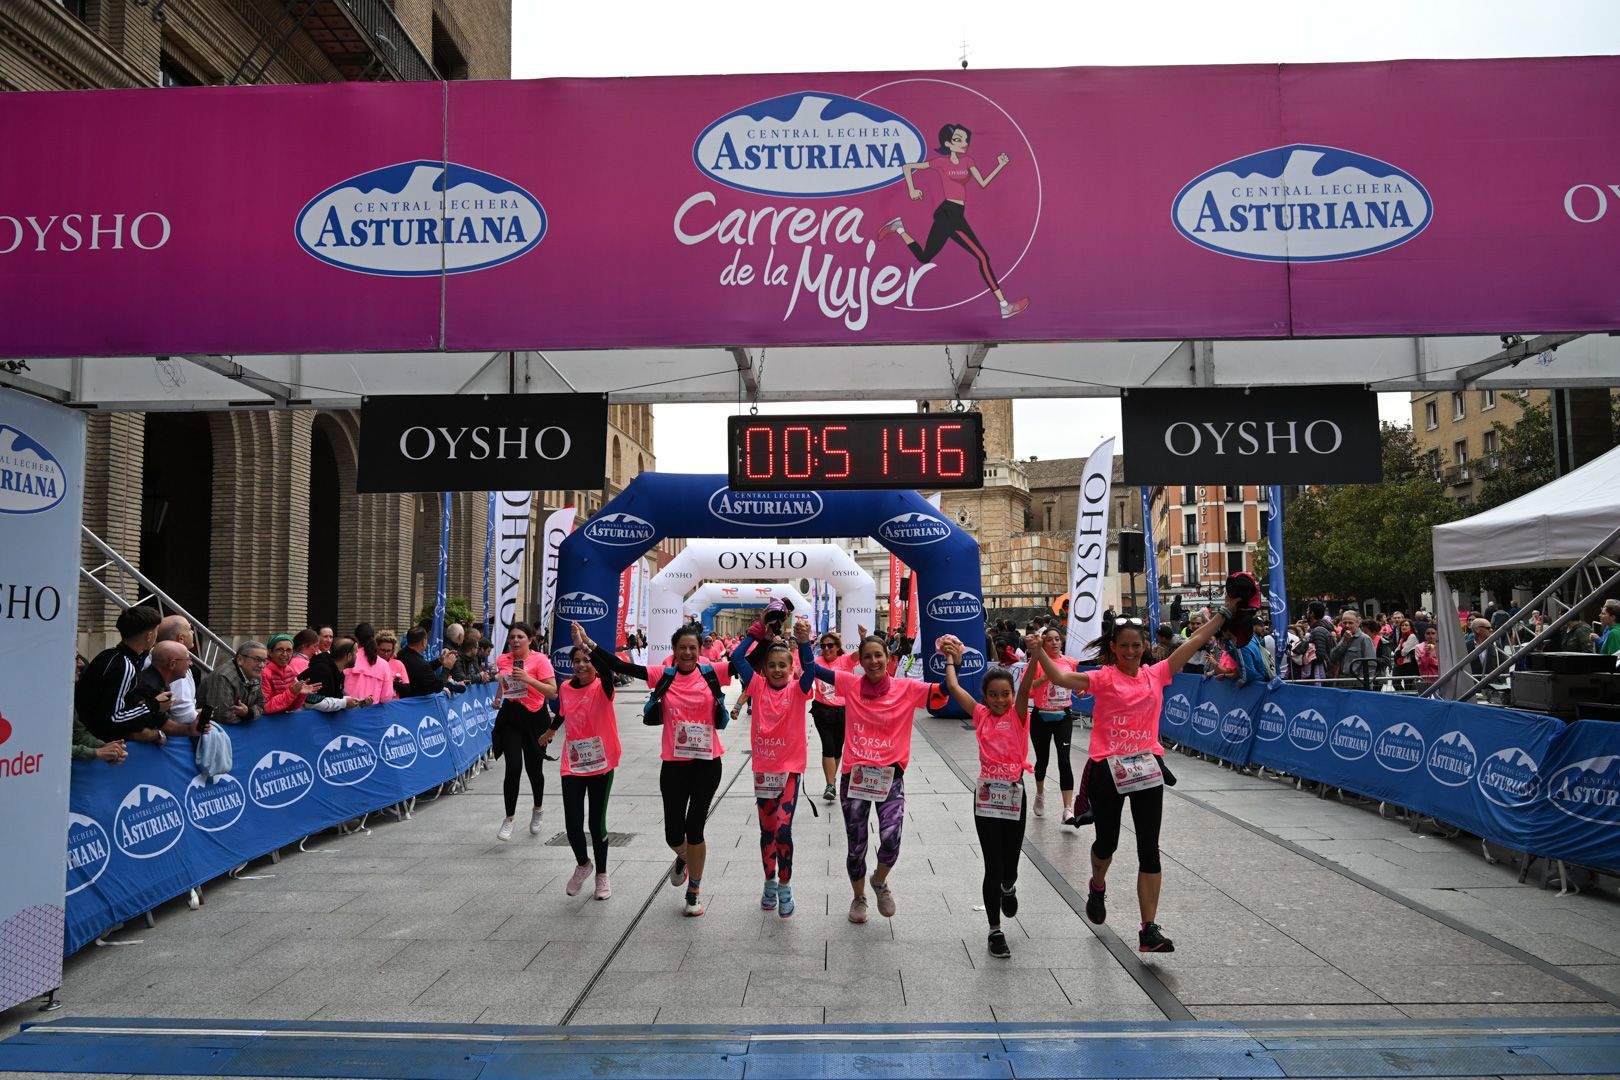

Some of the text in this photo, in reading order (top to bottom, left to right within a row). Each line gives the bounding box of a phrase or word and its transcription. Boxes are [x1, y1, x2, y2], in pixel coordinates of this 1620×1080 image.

[747, 126, 901, 140] CENTRAL LECHERA
[711, 131, 907, 171] ASTURIANA
[1231, 182, 1403, 198] CENTRAL LECHERA
[353, 199, 520, 213] CENTRAL LECHERA
[1192, 189, 1414, 233] ASTURIANA
[314, 204, 528, 248] ASTURIANA
[673, 191, 865, 246] Carrera
[720, 240, 938, 332] de la Mujer
[399, 425, 571, 461] OYSHO
[1164, 419, 1343, 457] OYSHO
[14, 457, 55, 474] LECHERA
[717, 494, 815, 515] ASTURIANA
[1199, 485, 1208, 525] OTEL
[588, 524, 649, 539] ASTURIANA
[885, 526, 947, 539] ASTURIANA
[1073, 472, 1107, 623] OYSHO
[718, 551, 808, 570] OYSHO
[664, 572, 693, 580] OYSHO
[832, 569, 860, 577] OYSHO
[0, 583, 61, 621] HO
[652, 607, 678, 615] OYSHO
[846, 606, 872, 614] OYSHO
[930, 603, 980, 615] ASTURIANA
[1112, 715, 1126, 726] TU
[1289, 721, 1325, 742] ASTURIANA
[384, 741, 417, 761] ASTURIANA
[1331, 728, 1368, 752] ASTURIANA
[1376, 737, 1420, 763] ASTURIANA
[323, 752, 375, 778] ASTURIANA
[254, 770, 311, 800] ASTURIANA
[190, 791, 243, 821] ASTURIANA
[122, 809, 183, 849] ASTURIANA
